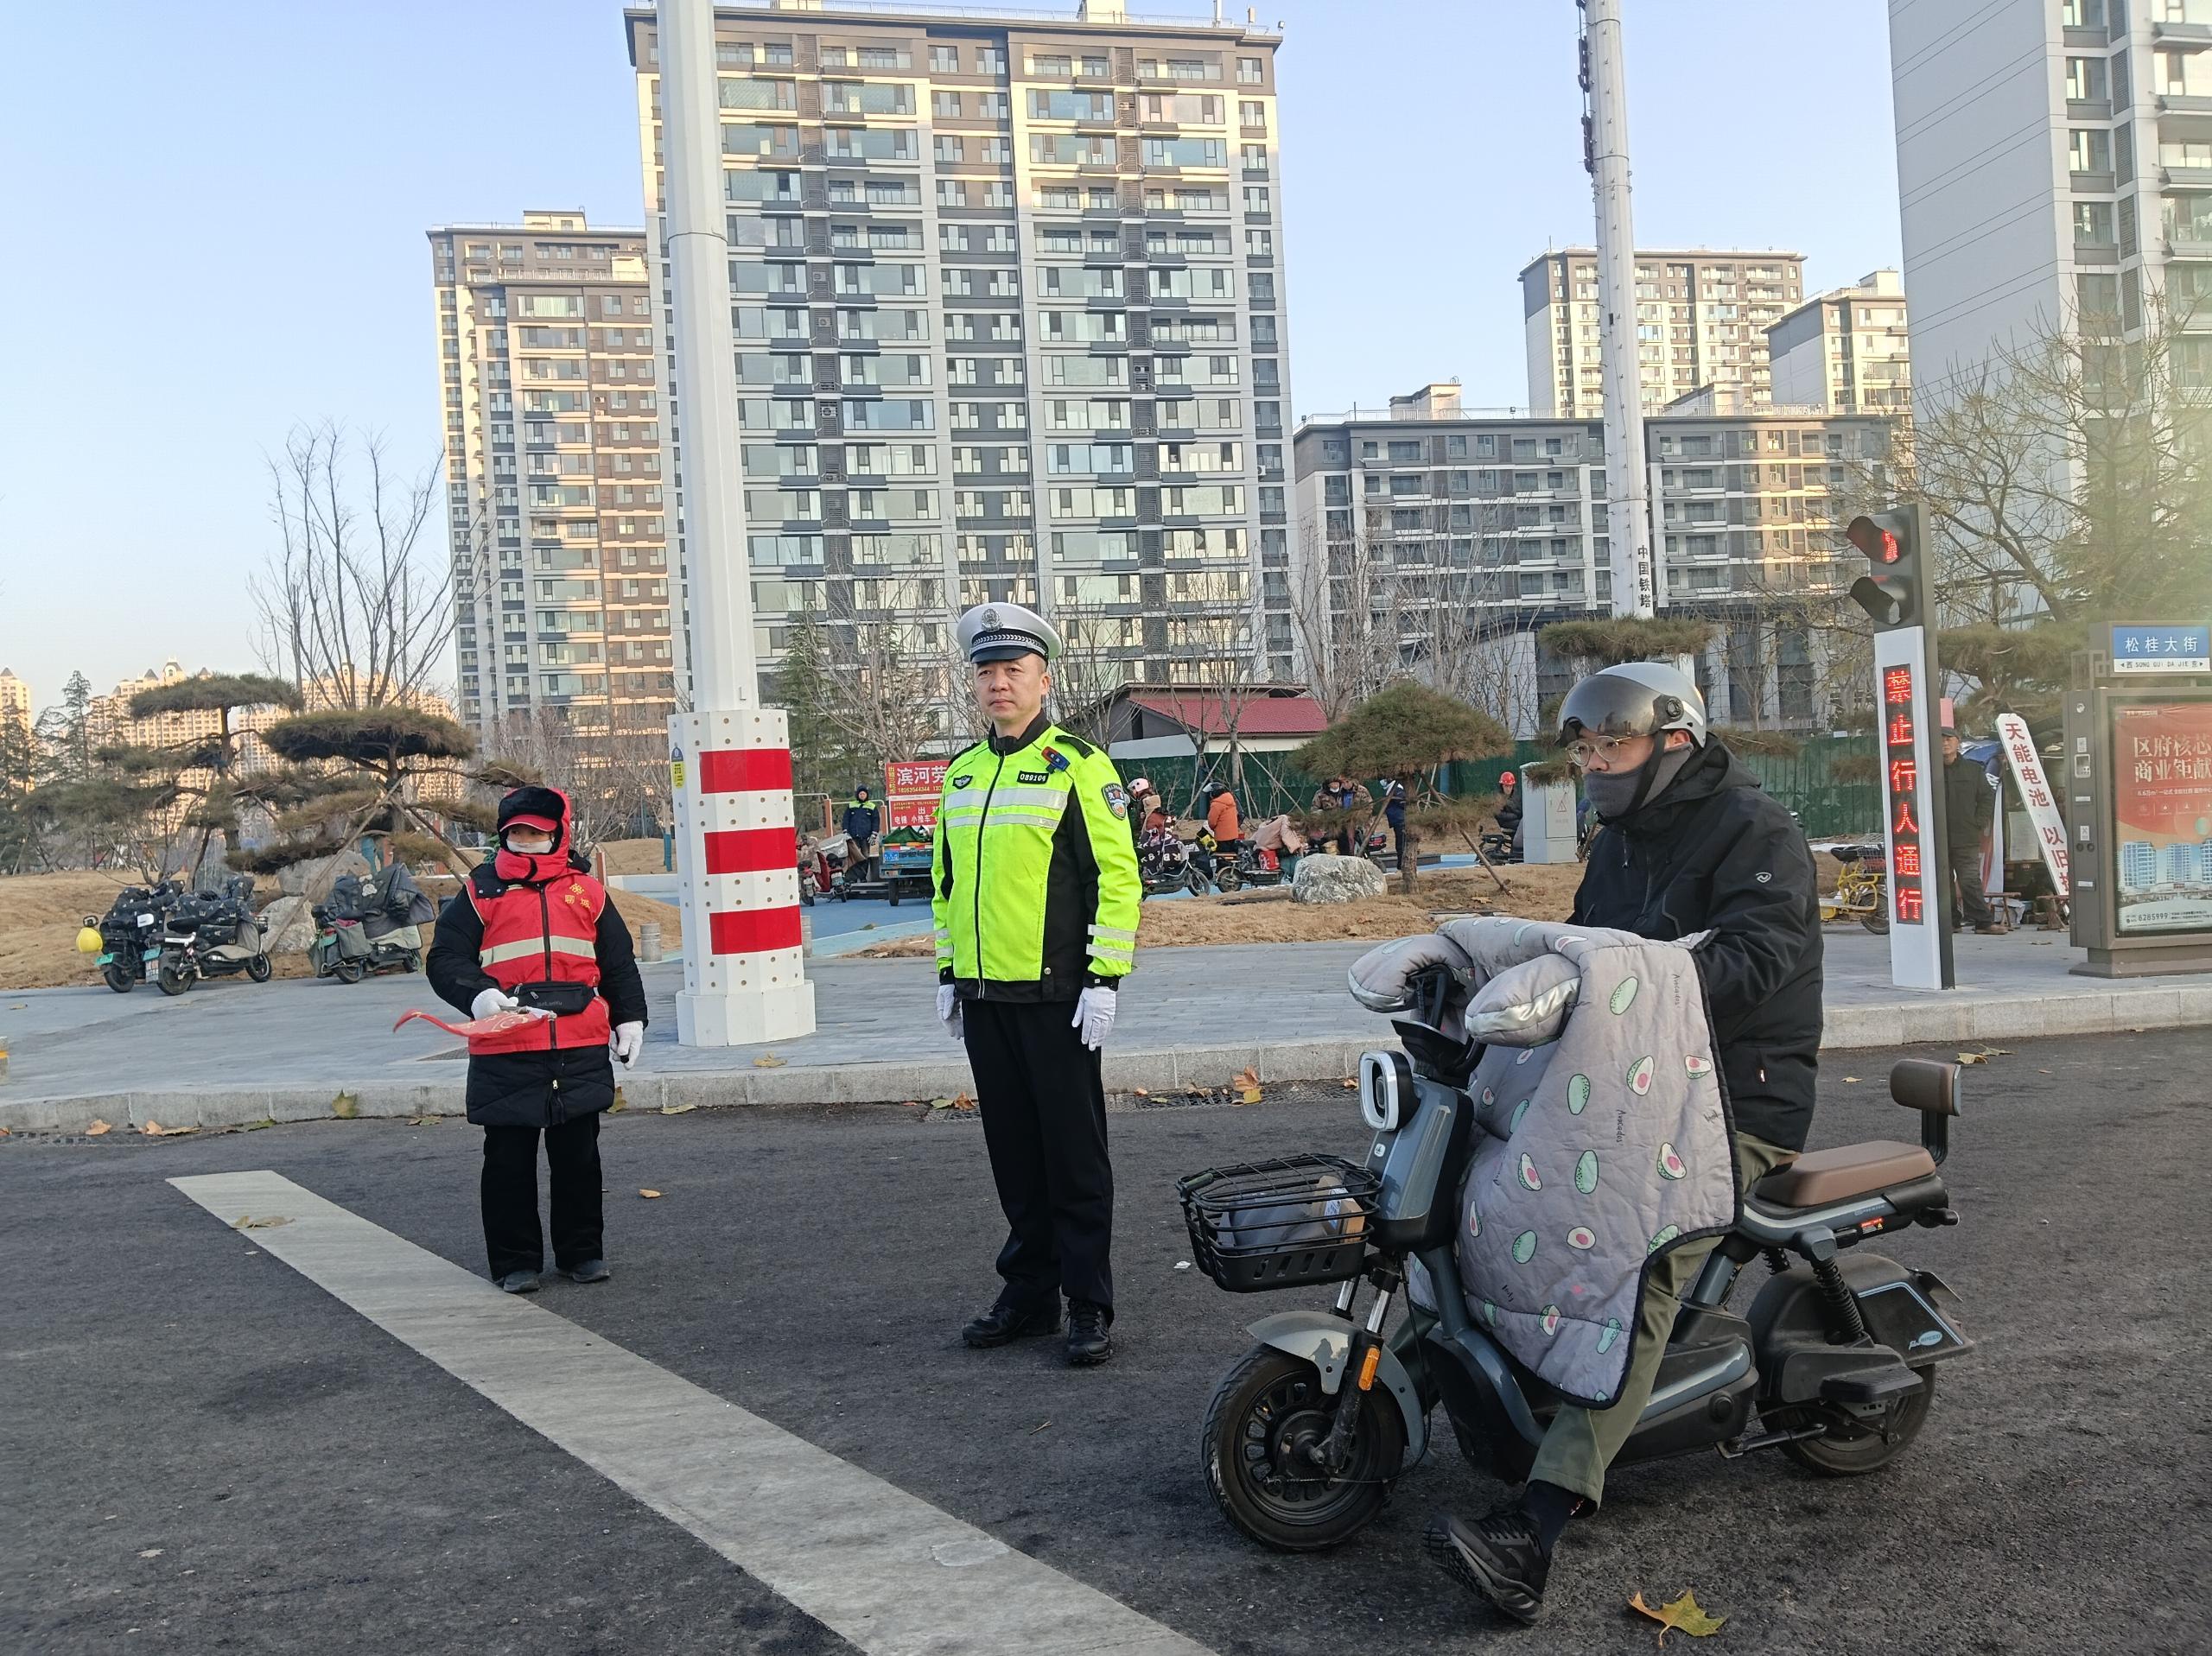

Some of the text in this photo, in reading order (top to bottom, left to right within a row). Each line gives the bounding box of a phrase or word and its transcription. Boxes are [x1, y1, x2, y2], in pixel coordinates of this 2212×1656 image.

[1637, 544, 1651, 608] 中国铁塔
[2124, 636, 2198, 653] 松桂大街
[2133, 733, 2212, 758] 区府核芯
[896, 765, 948, 785] 滨河劳
[2005, 723, 2050, 808] 天能电池
[2134, 757, 2212, 784] 商业钜献
[1887, 669, 1923, 919] 禁止行人通行
[2138, 912, 2169, 922] 6285999
